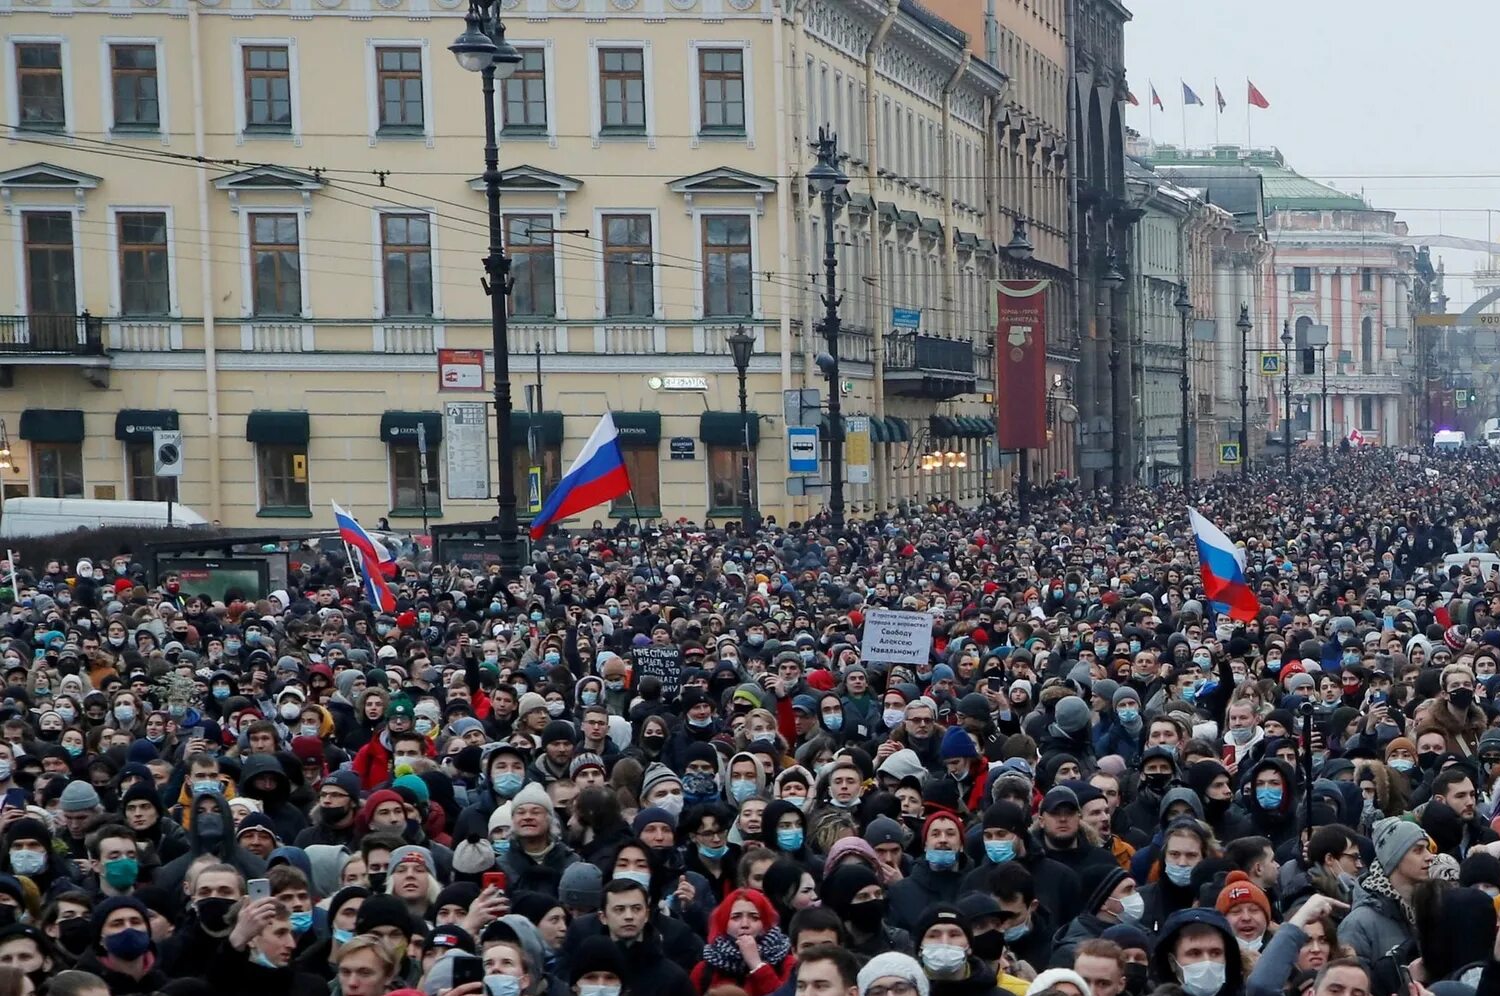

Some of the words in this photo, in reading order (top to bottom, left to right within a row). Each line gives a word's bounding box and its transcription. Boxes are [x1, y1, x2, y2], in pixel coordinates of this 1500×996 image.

[1480, 316, 1500, 325] 900
[881, 628, 913, 637] Свободу
[879, 638, 913, 646] Алексею
[870, 647, 920, 656] Навальному!
